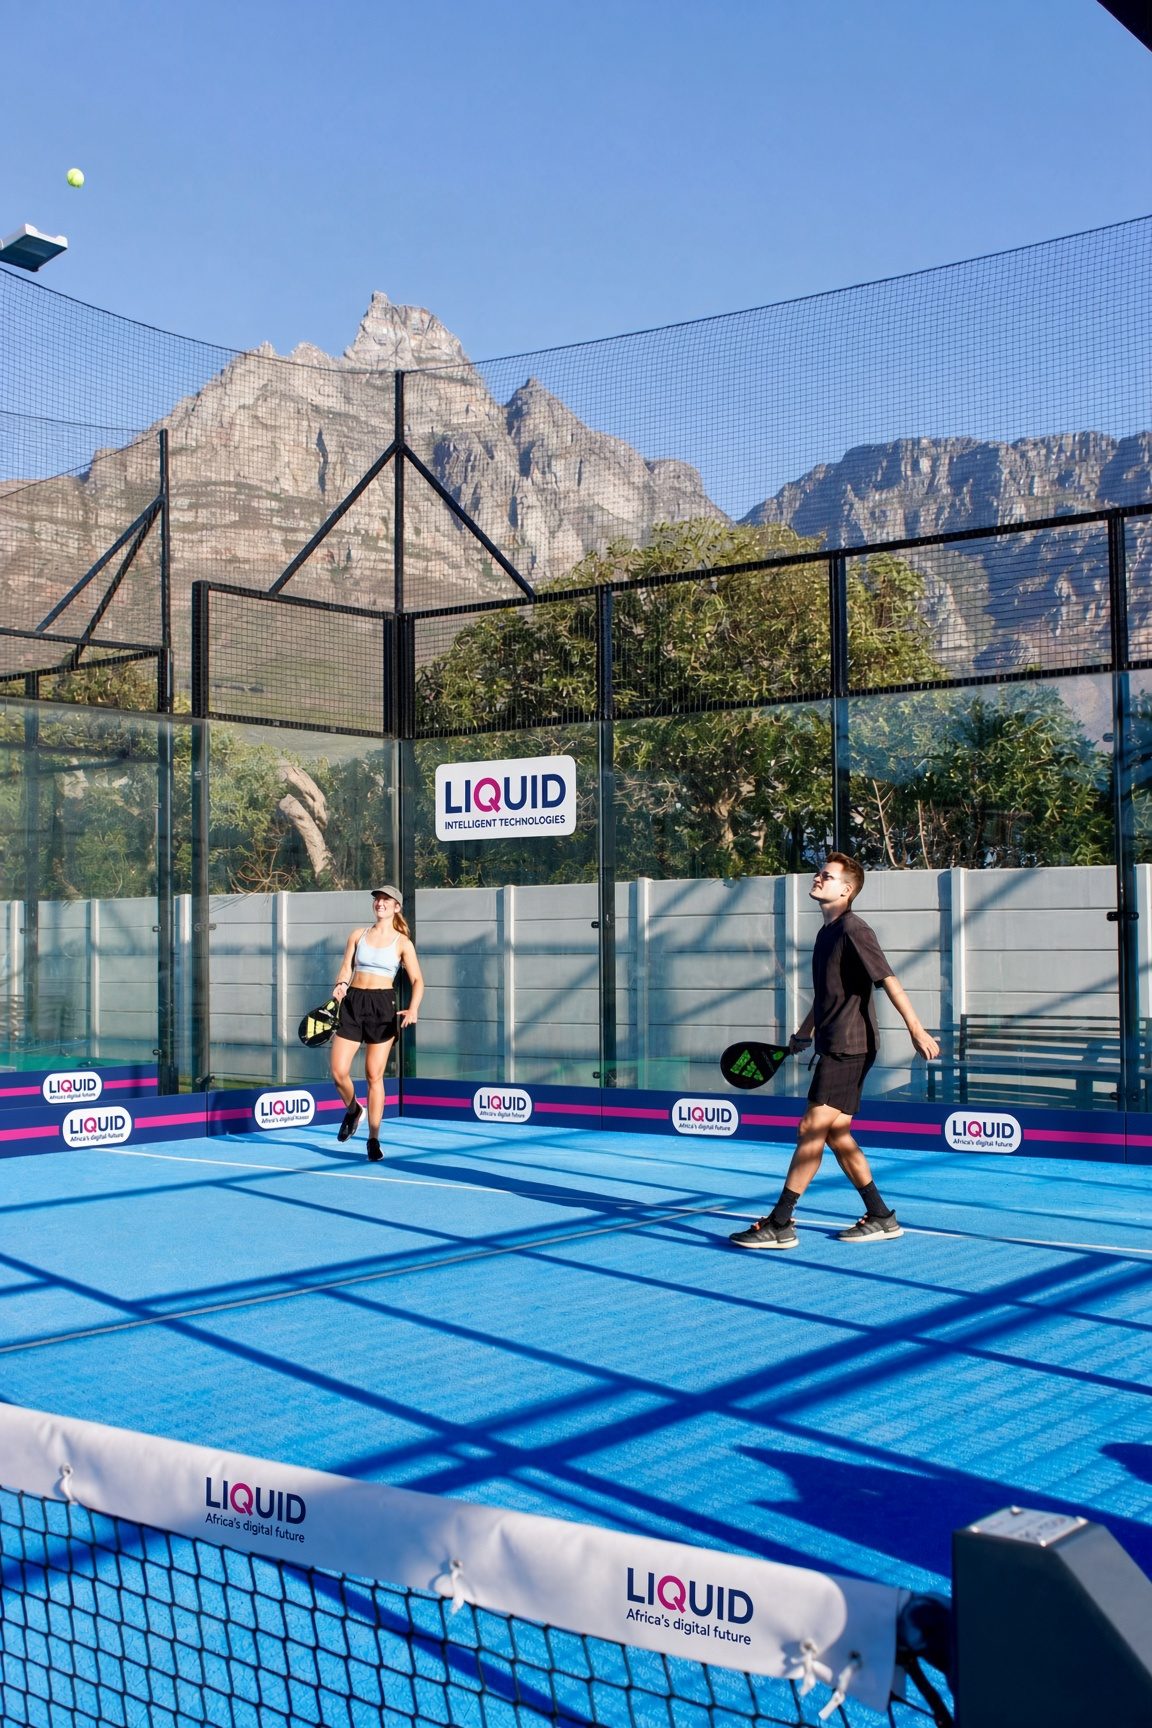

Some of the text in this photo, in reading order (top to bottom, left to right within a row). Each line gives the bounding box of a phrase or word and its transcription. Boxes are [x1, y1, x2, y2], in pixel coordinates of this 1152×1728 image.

[445, 773, 567, 814] LIQUID
[445, 814, 566, 830] INTELLIGENT TECHNOLOGIES
[49, 1078, 97, 1094] LIQUID
[261, 1098, 310, 1116] LIQUID
[479, 1094, 527, 1111] LIQUID
[678, 1106, 732, 1123] LIQUID
[69, 1115, 126, 1134] LIQUID
[952, 1120, 1015, 1138] LIQUID
[205, 1476, 306, 1525] LIQUID
[205, 1512, 305, 1543] Africa's digital future
[627, 1567, 754, 1625] LIQUID
[626, 1608, 751, 1646] Africa's digital future
